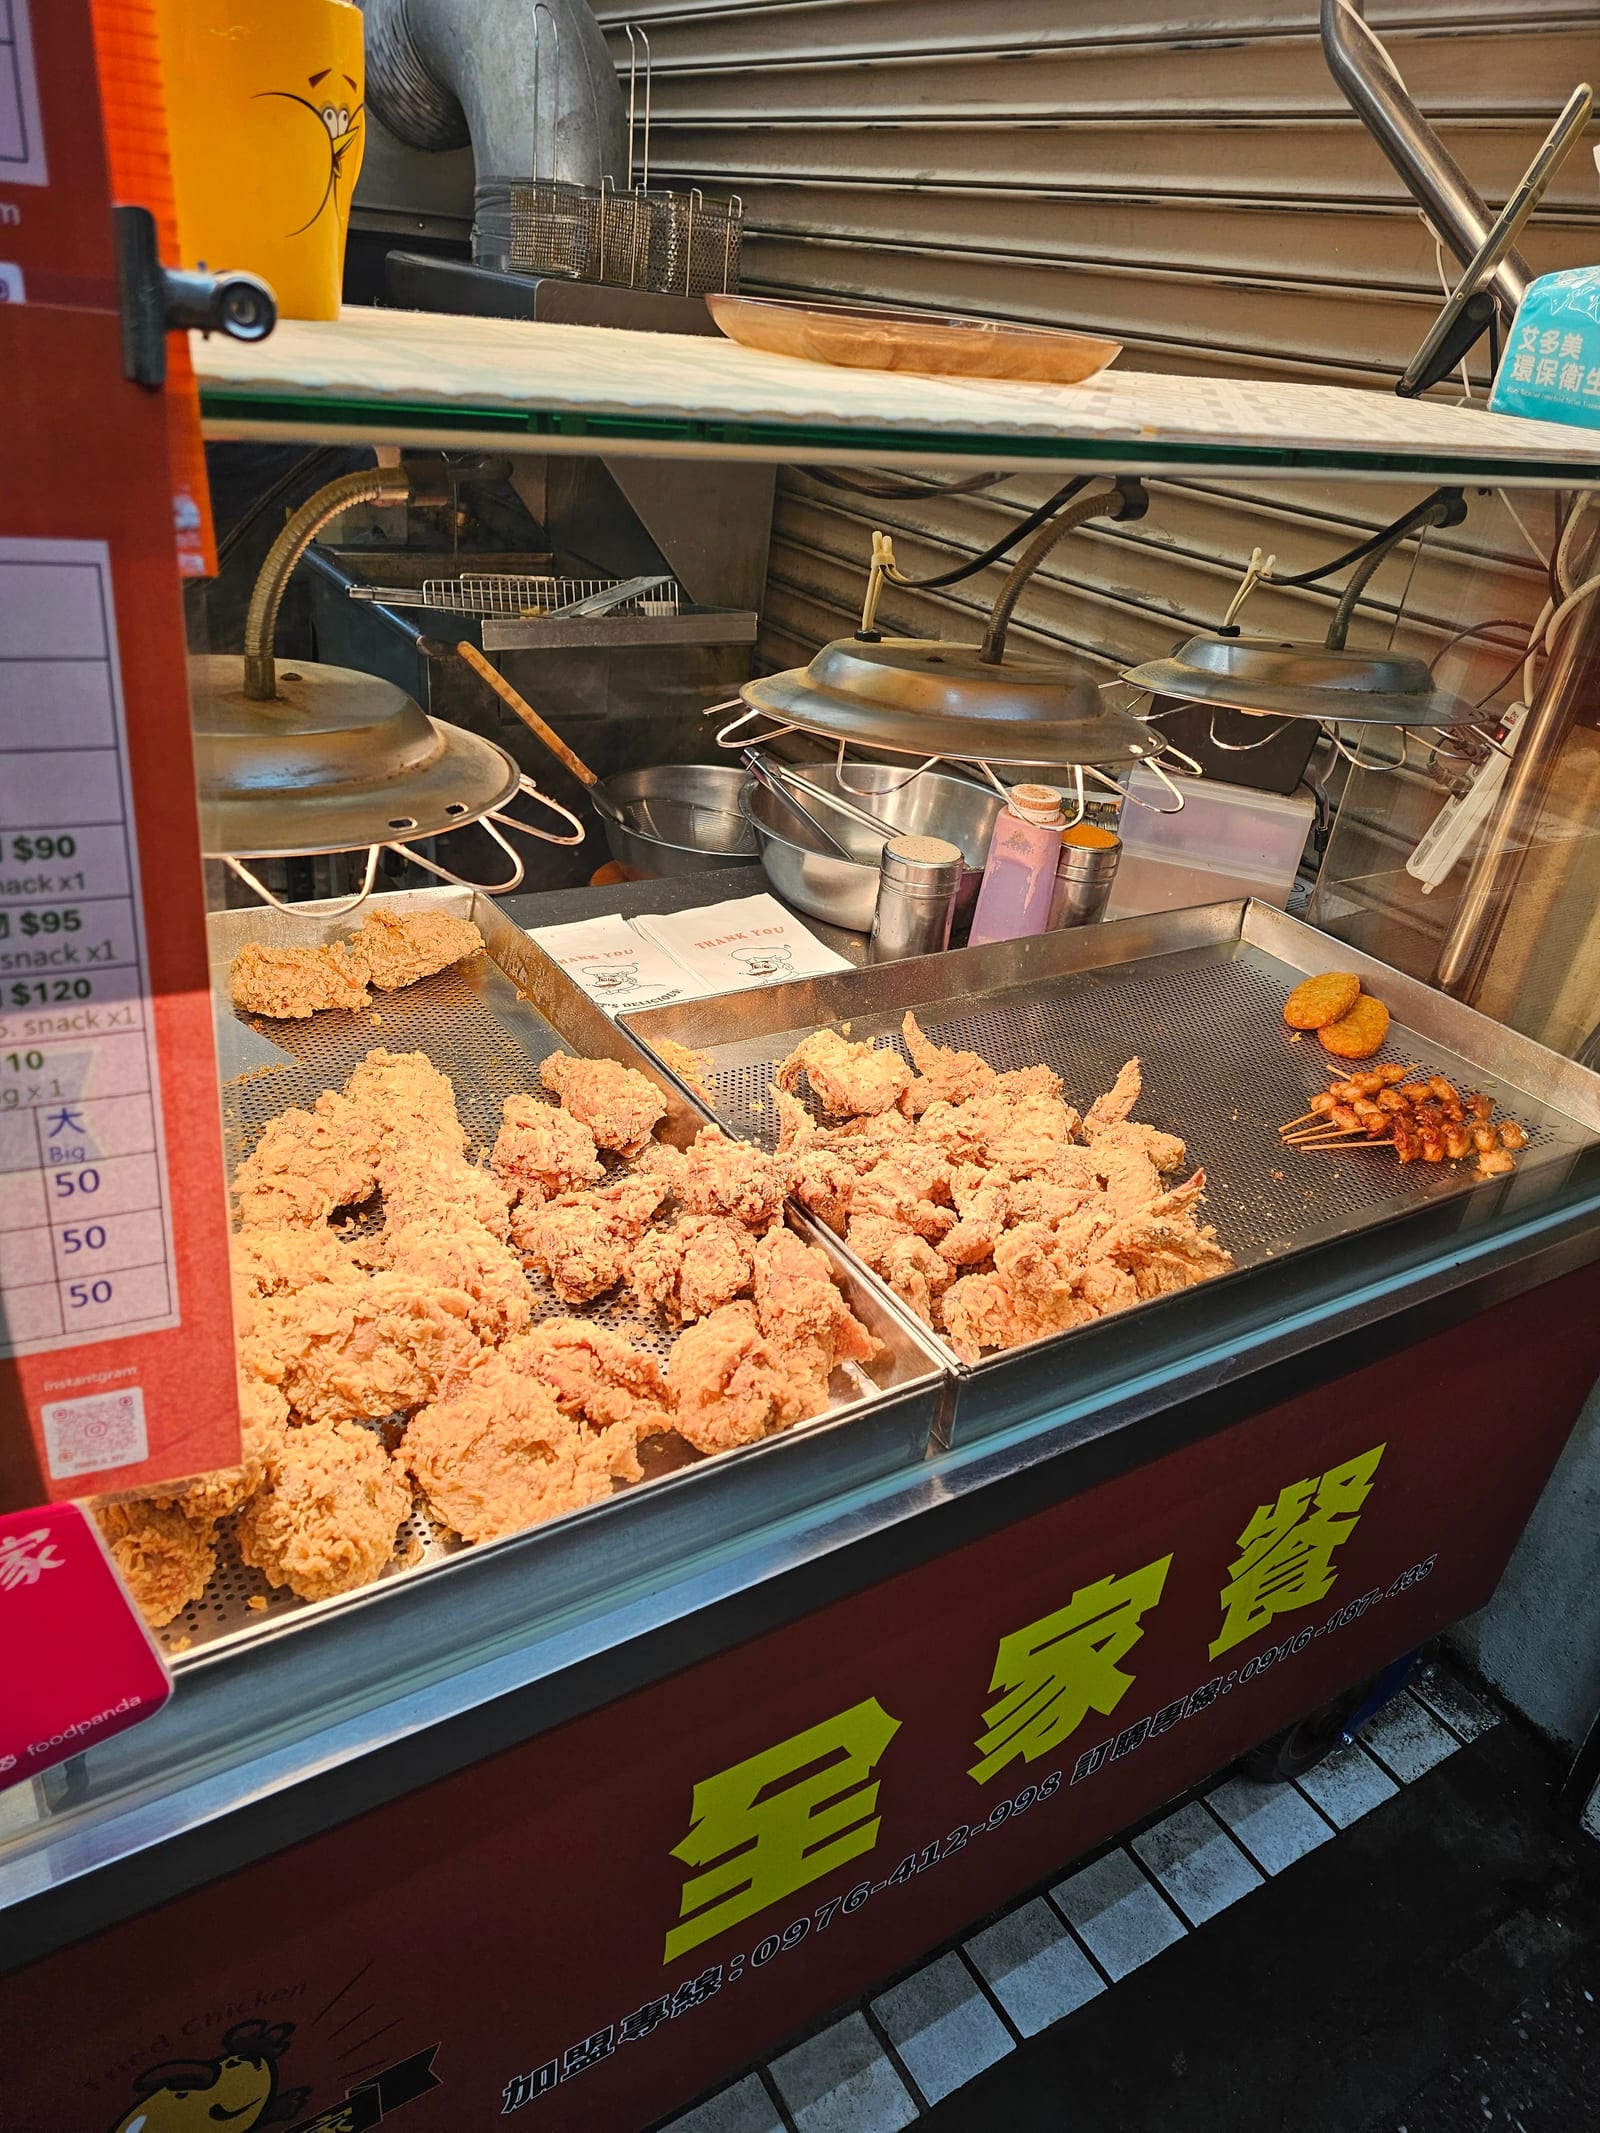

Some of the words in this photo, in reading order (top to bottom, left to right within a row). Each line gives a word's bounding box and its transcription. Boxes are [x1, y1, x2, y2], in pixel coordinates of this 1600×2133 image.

[1517, 326, 1584, 360] 艾多美
[13, 835, 76, 864] $90
[59, 872, 85, 891] x1
[20, 909, 81, 937] $95
[694, 932, 748, 949] THANK
[751, 926, 785, 937] YOU
[0, 943, 76, 970] snack
[87, 940, 117, 962] x1
[602, 948, 634, 958] YOU
[11, 979, 91, 1007] $120
[24, 1009, 99, 1036] snack
[107, 1006, 136, 1026] x1
[47, 1108, 85, 1138] 大
[49, 1146, 85, 1162] Big
[55, 1168, 100, 1198] 50
[62, 1225, 106, 1254] 50
[69, 1280, 112, 1308] 50
[27, 1695, 142, 1757] foodpanda
[181, 1982, 308, 2037] Chicken
